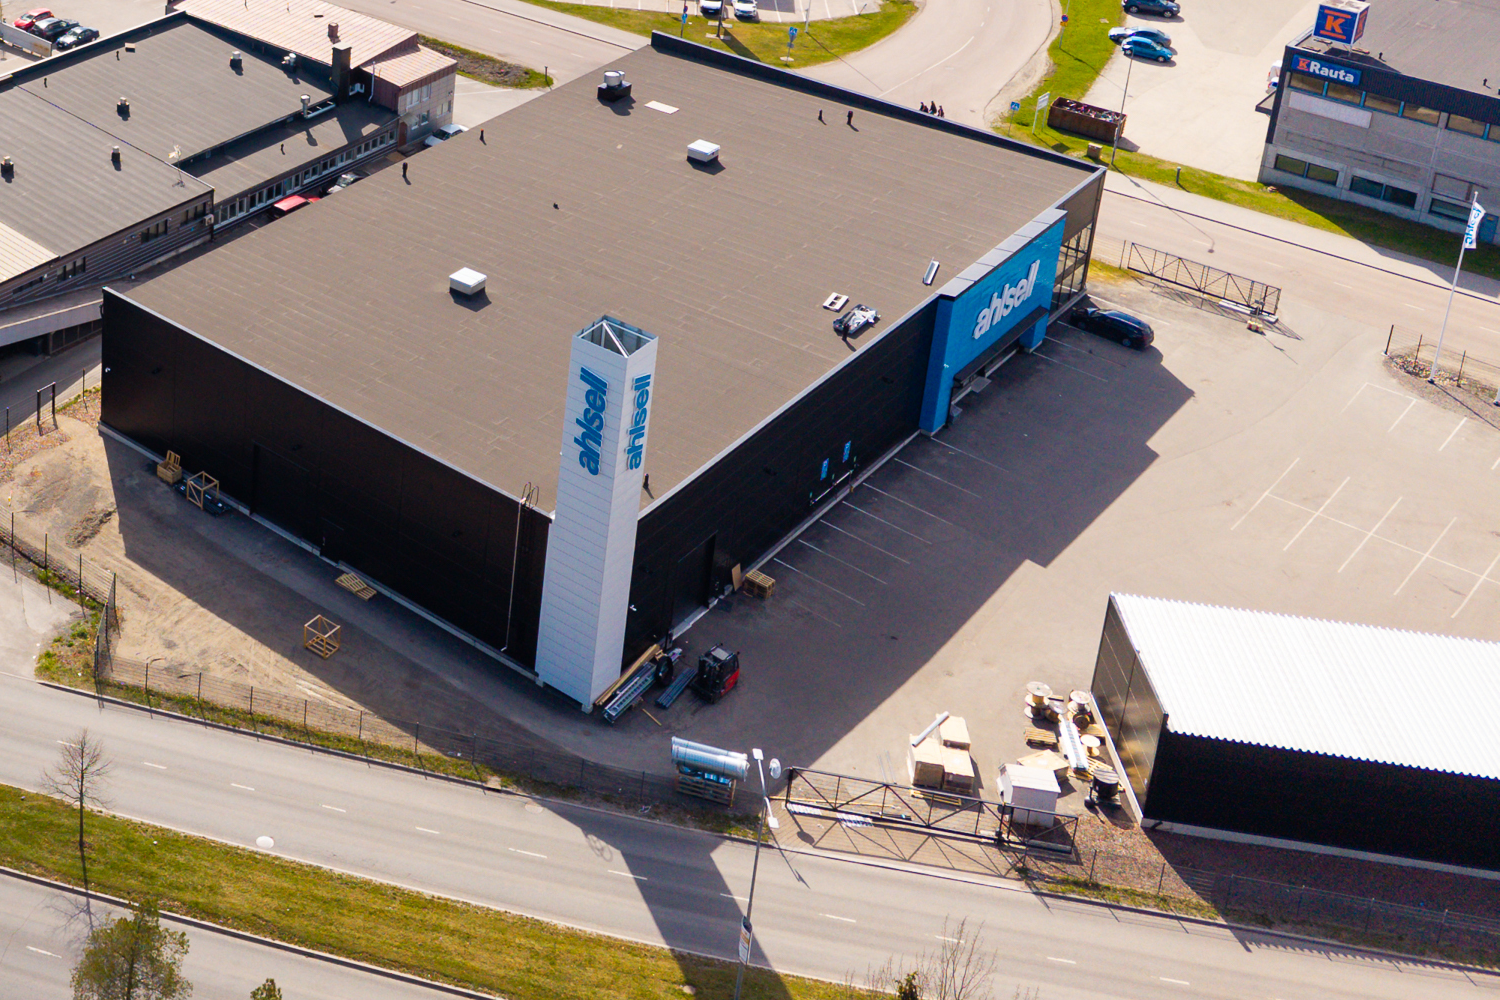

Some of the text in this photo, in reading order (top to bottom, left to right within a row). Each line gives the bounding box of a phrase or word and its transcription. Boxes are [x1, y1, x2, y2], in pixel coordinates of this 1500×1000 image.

[1325, 15, 1345, 34] K
[973, 259, 1040, 339] ahlsell
[574, 366, 608, 476] ahlsell
[626, 373, 651, 471] ahlsell
